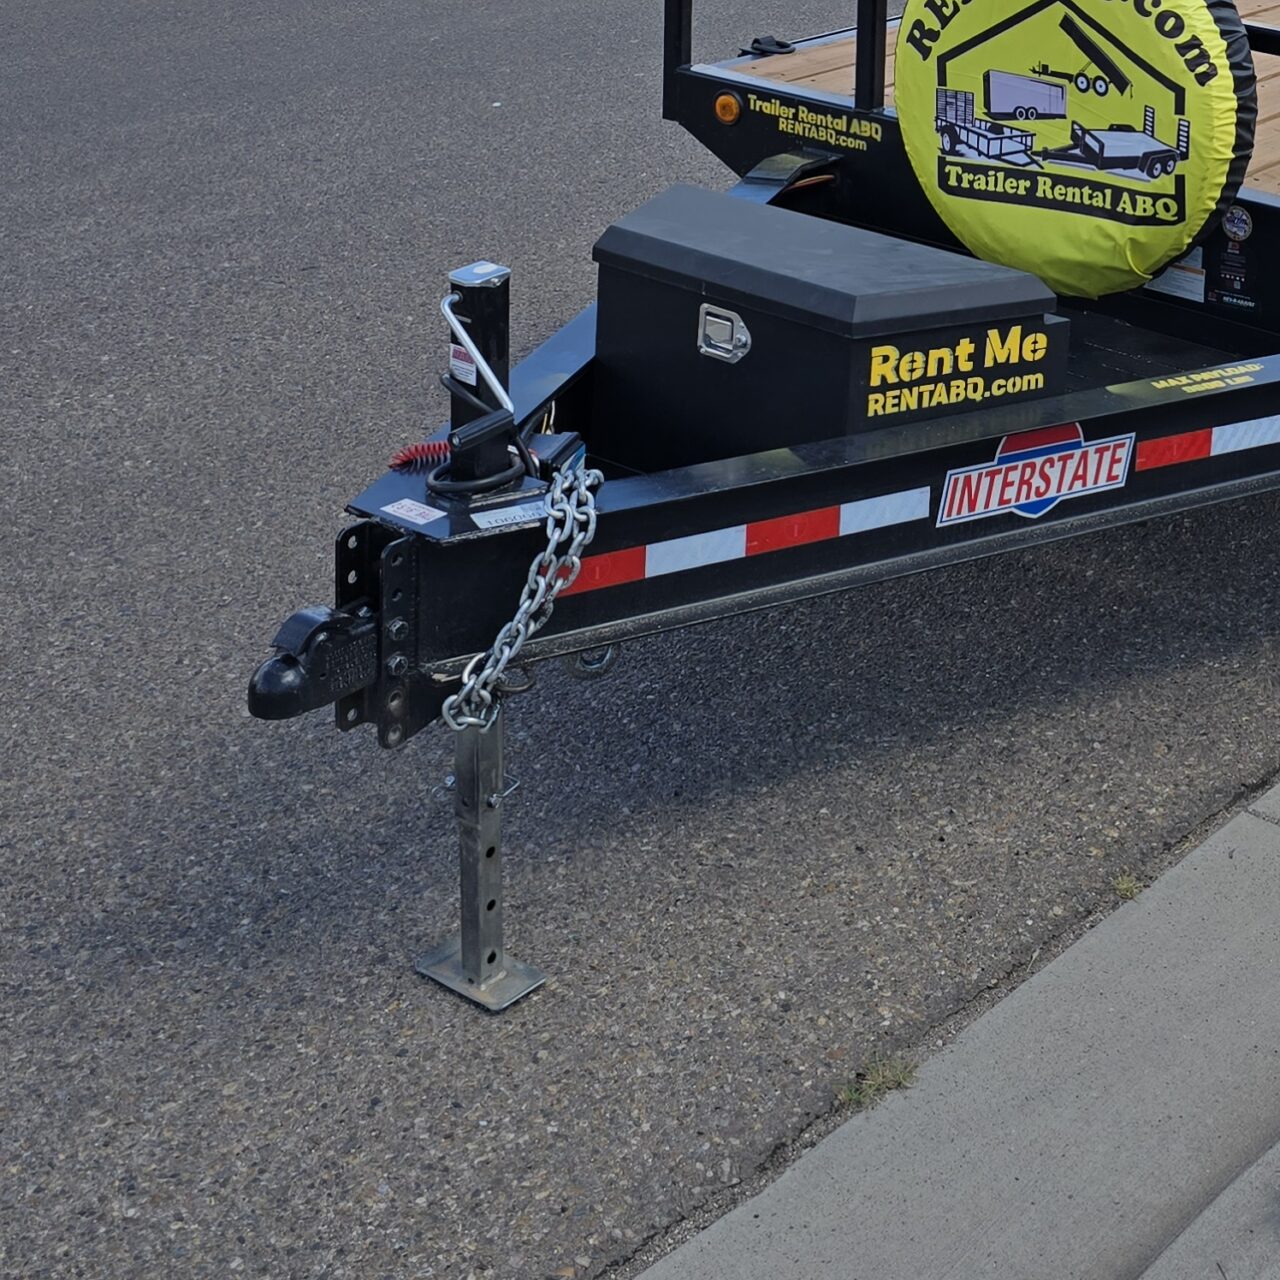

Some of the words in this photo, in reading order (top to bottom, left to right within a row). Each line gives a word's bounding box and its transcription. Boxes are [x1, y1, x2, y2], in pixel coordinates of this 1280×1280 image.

[748, 94, 795, 119] Trailer
[798, 105, 847, 132] Rental
[849, 119, 882, 142] ABQ
[778, 118, 867, 151] RENTABQ.com
[944, 165, 1030, 196] Trailer
[1036, 175, 1112, 210] Rental
[1117, 193, 1178, 221] ABQ
[869, 338, 975, 387] Rent
[983, 325, 1049, 369] Me
[867, 372, 1044, 417] RENTABQ.com
[945, 439, 1127, 515] INTERSTATE
